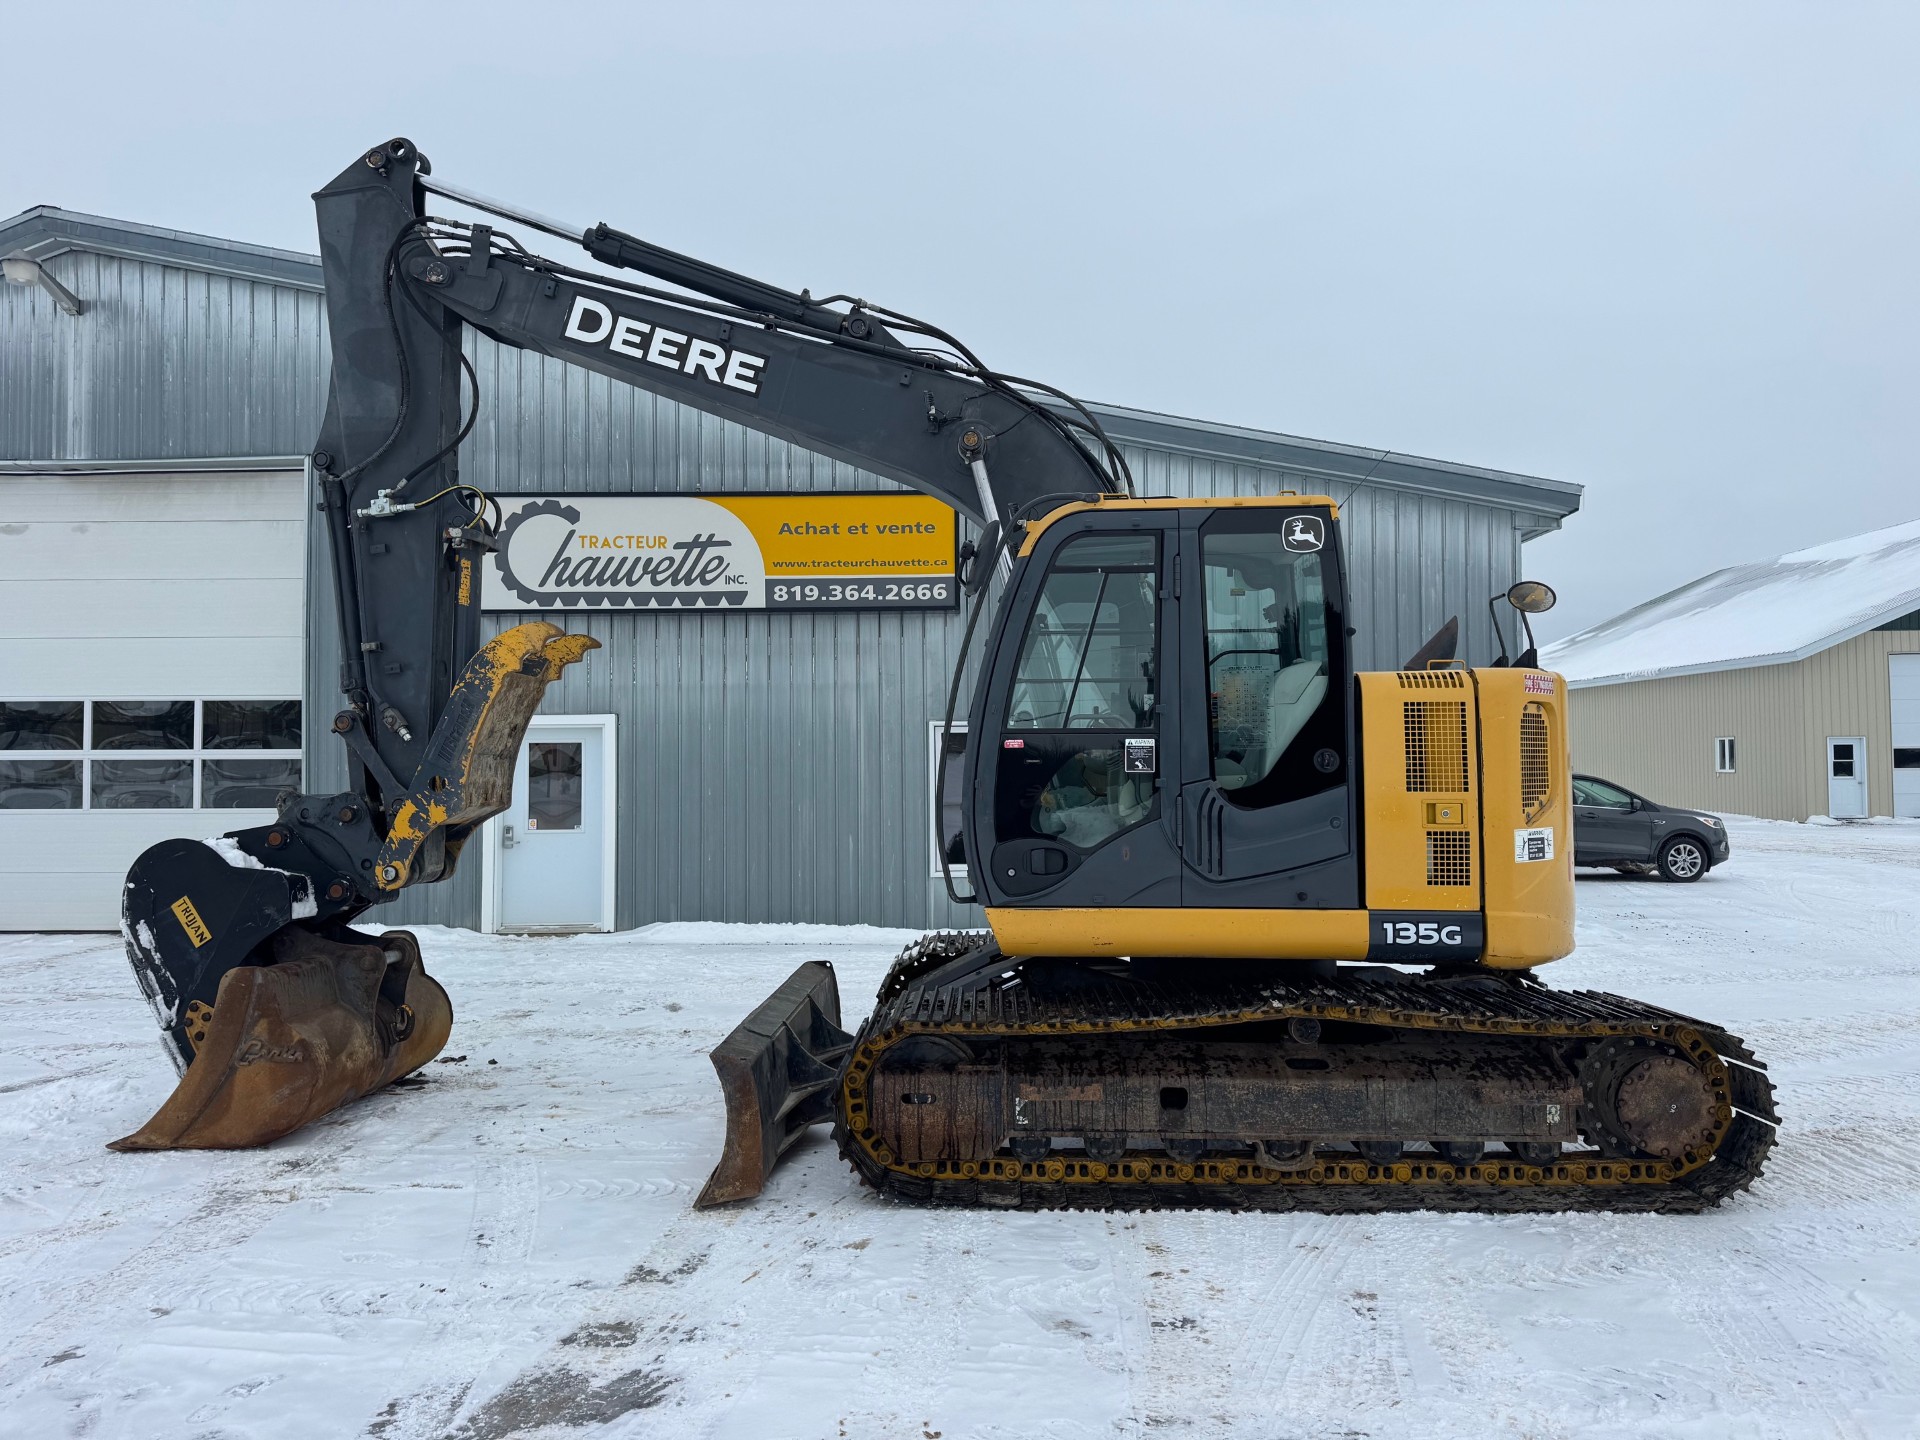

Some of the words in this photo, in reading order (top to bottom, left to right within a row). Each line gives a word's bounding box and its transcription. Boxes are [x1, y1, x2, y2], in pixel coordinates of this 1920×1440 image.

[564, 295, 765, 394] DEERE
[778, 522, 840, 535] Achat
[847, 523, 869, 535] et
[876, 521, 936, 534] vente
[495, 499, 740, 606] Chauvette
[724, 574, 748, 585] INC.
[579, 535, 668, 549] TRACTEUR
[772, 558, 948, 568] www.tracteurchauvette.ca
[773, 583, 948, 602] 819.364.2666
[177, 898, 208, 943] TROJAN
[1383, 922, 1462, 945] 135G
